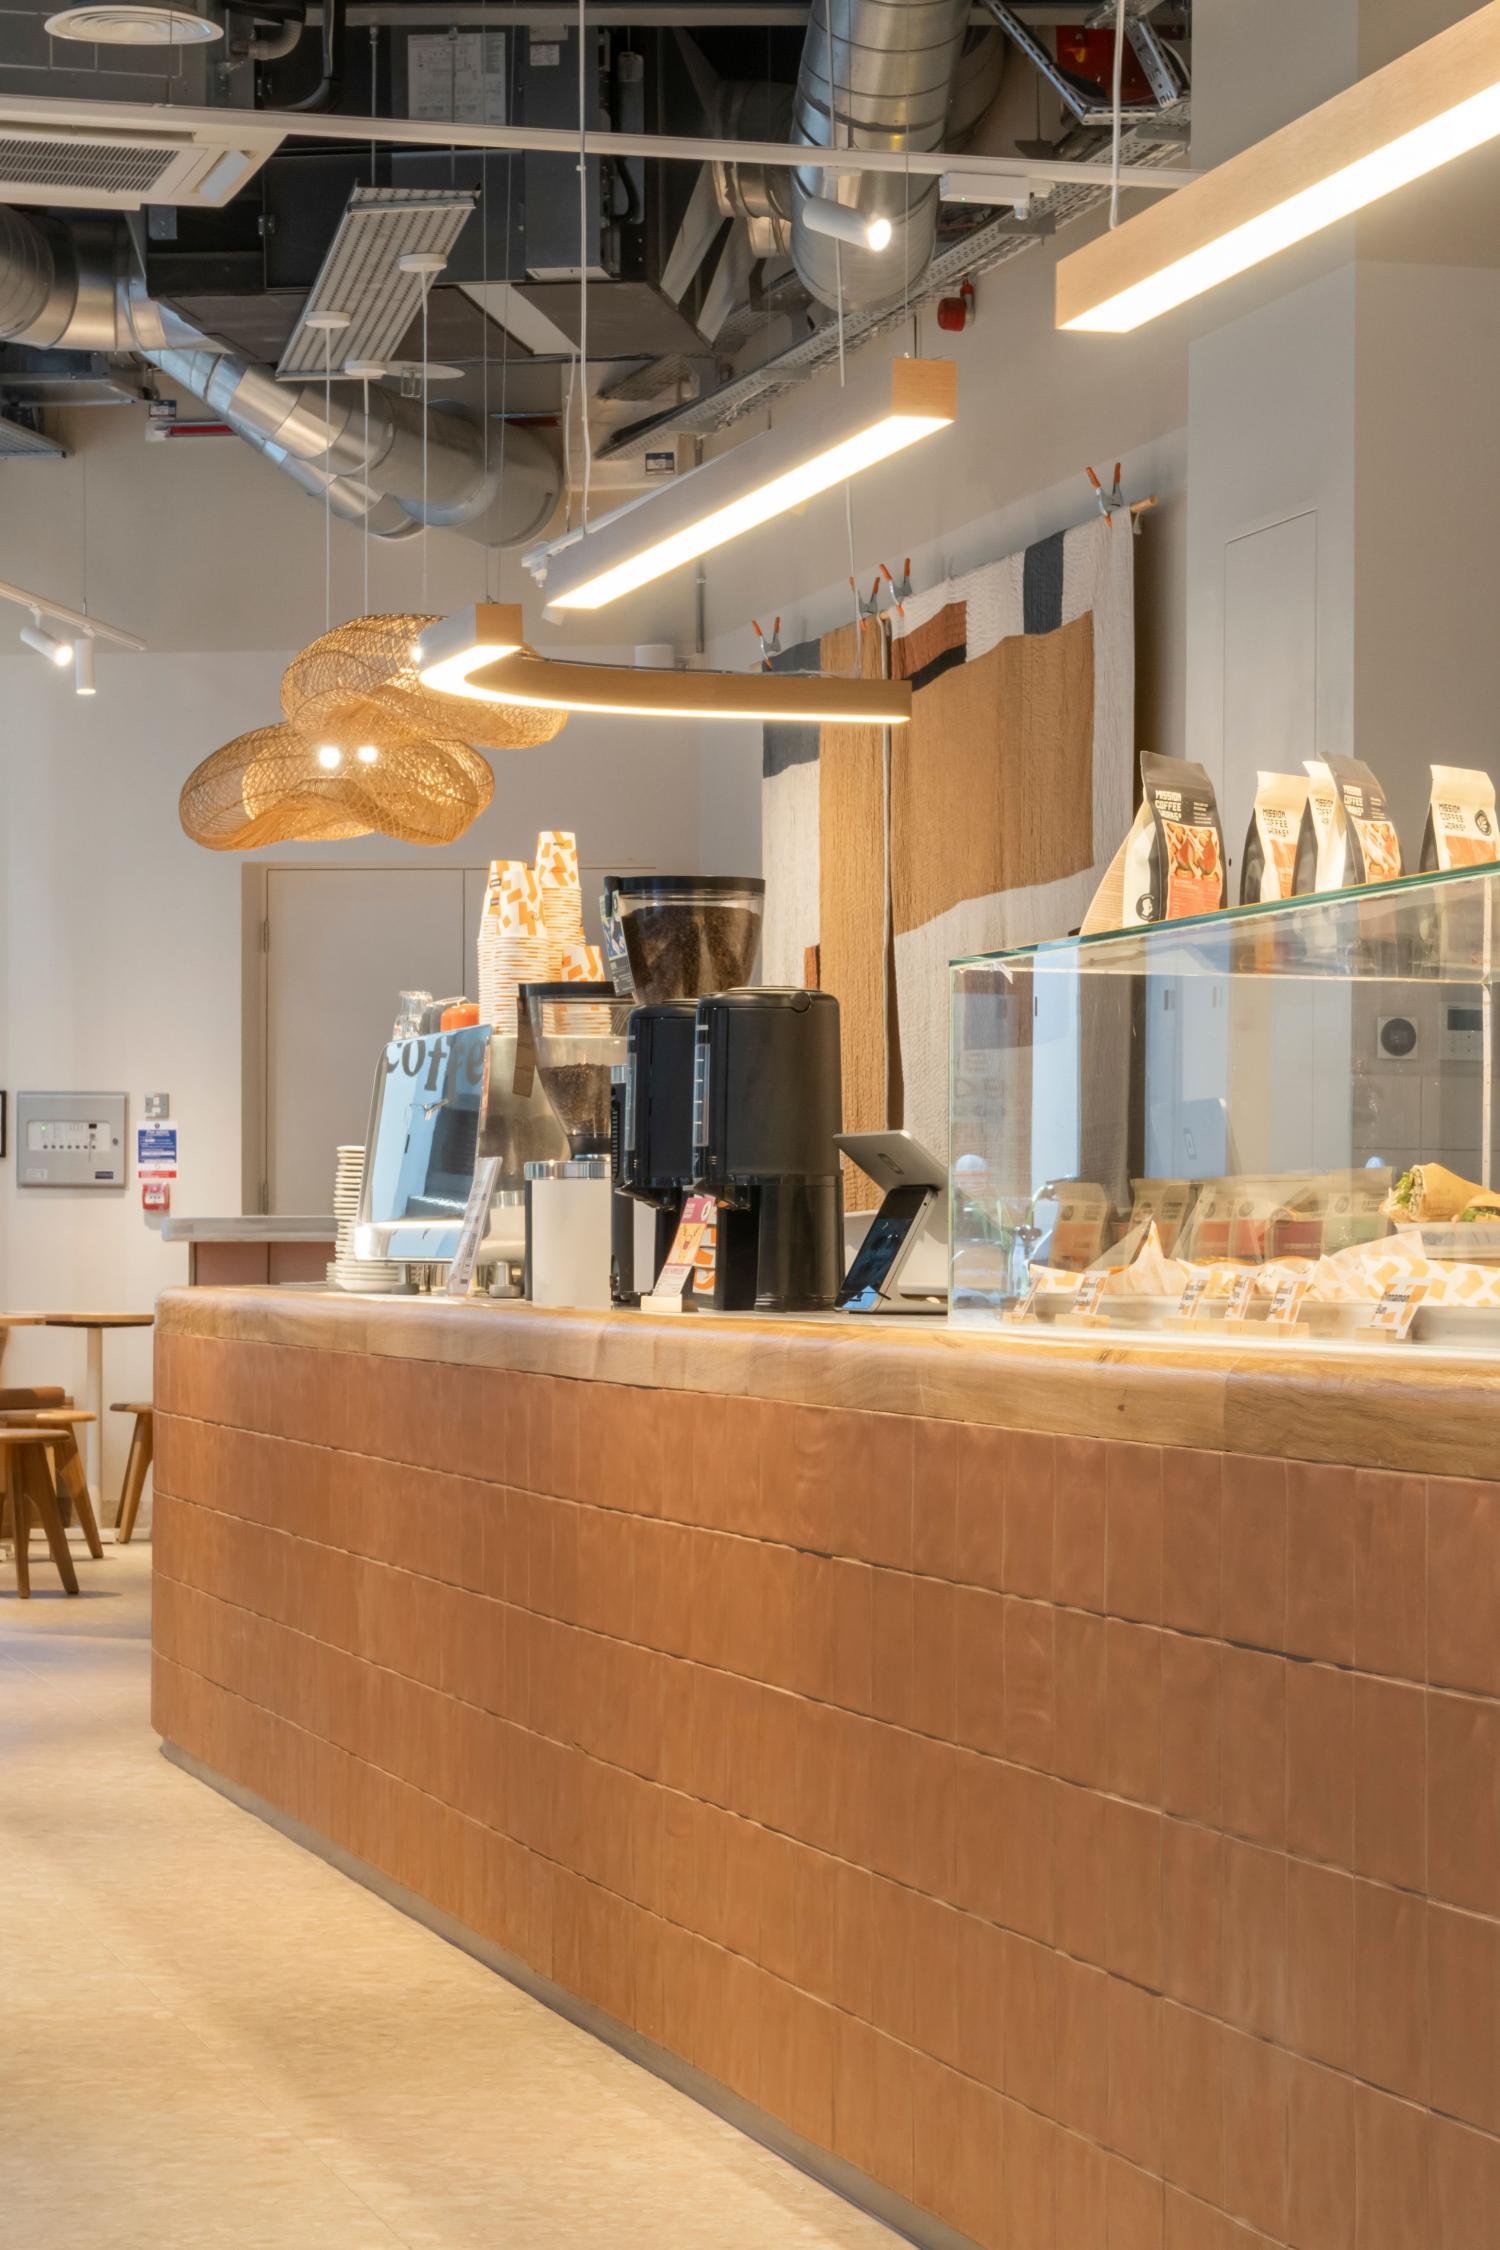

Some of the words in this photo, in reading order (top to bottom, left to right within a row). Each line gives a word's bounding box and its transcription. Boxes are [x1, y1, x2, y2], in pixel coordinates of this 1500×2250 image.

[1155, 790, 1181, 802] MISSION
[1343, 795, 1363, 807] COFFEE
[1154, 800, 1181, 812] COFFEE
[1263, 808, 1286, 818] MISSION
